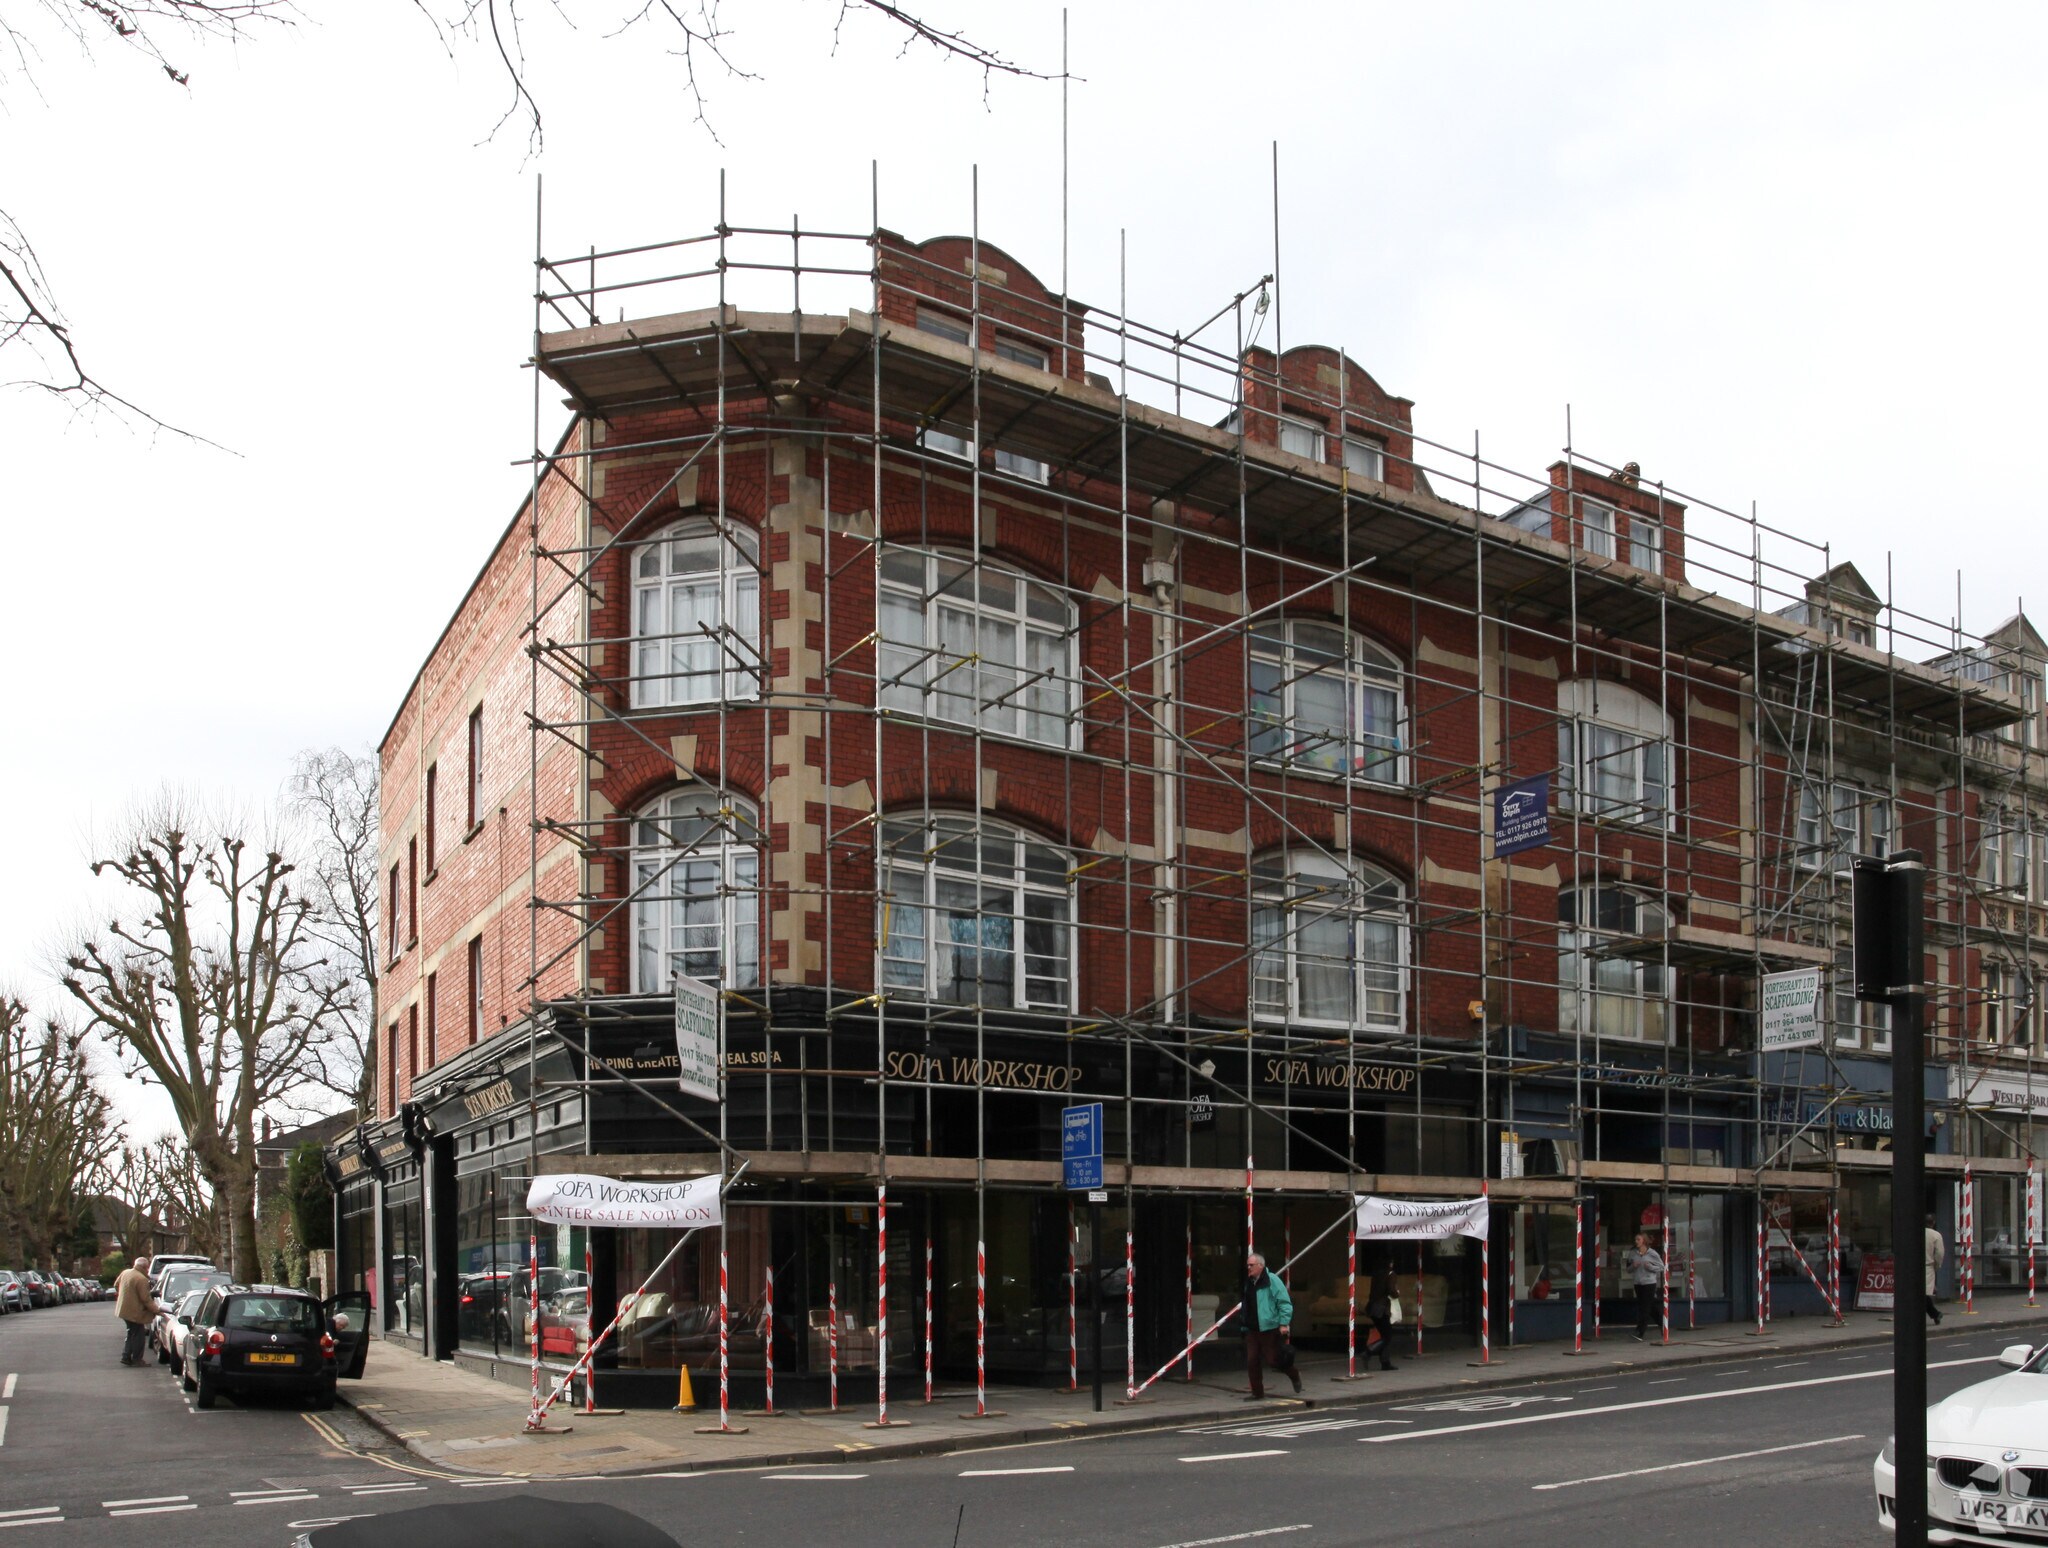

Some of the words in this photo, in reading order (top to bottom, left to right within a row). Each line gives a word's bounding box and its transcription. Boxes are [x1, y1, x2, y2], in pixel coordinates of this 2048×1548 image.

[1502, 808, 1520, 817] Olpin
[1503, 802, 1520, 812] Terry
[1502, 817, 1520, 827] Building
[1520, 811, 1539, 821] Services
[1507, 825, 1520, 835] 0117
[1522, 822, 1532, 830] 926
[1532, 816, 1547, 827] 0978
[1496, 825, 1548, 847] www.olpin.co.uk
[1765, 978, 1802, 994] NORTHGRANT
[1803, 977, 1815, 989] LTD
[1765, 990, 1814, 1011] SCAFFOLDING
[677, 1007, 715, 1040] SCAFFOLDING
[1766, 1020, 1781, 1029] 0117
[1782, 1018, 1794, 1026] 964
[1796, 1015, 1813, 1023] 7000
[1765, 1034, 1785, 1043] 07747
[1787, 1032, 1800, 1040] 443
[588, 1057, 634, 1070] HEPING
[680, 1046, 694, 1059] 0117
[704, 1054, 715, 1067] 7000
[682, 1068, 698, 1082] 07747
[887, 1051, 944, 1081] SOFA
[951, 1056, 1082, 1091] WORKSHOP
[1264, 1059, 1311, 1085] SOFA
[1316, 1066, 1415, 1091] WORKSHOP
[1856, 1109, 1868, 1128] &
[553, 1180, 594, 1199] SOFA
[599, 1183, 693, 1204] WORKSHOP
[537, 1205, 593, 1220] WINTER
[597, 1208, 635, 1221] SALE
[640, 1209, 679, 1221] NOW
[685, 1207, 711, 1220] ON
[1383, 1203, 1412, 1217] SOFA
[1412, 1204, 1473, 1217] WORKSHOP
[1370, 1224, 1410, 1234] WINTER
[1412, 1224, 1437, 1234] SALE
[1864, 1274, 1894, 1289] 50%
